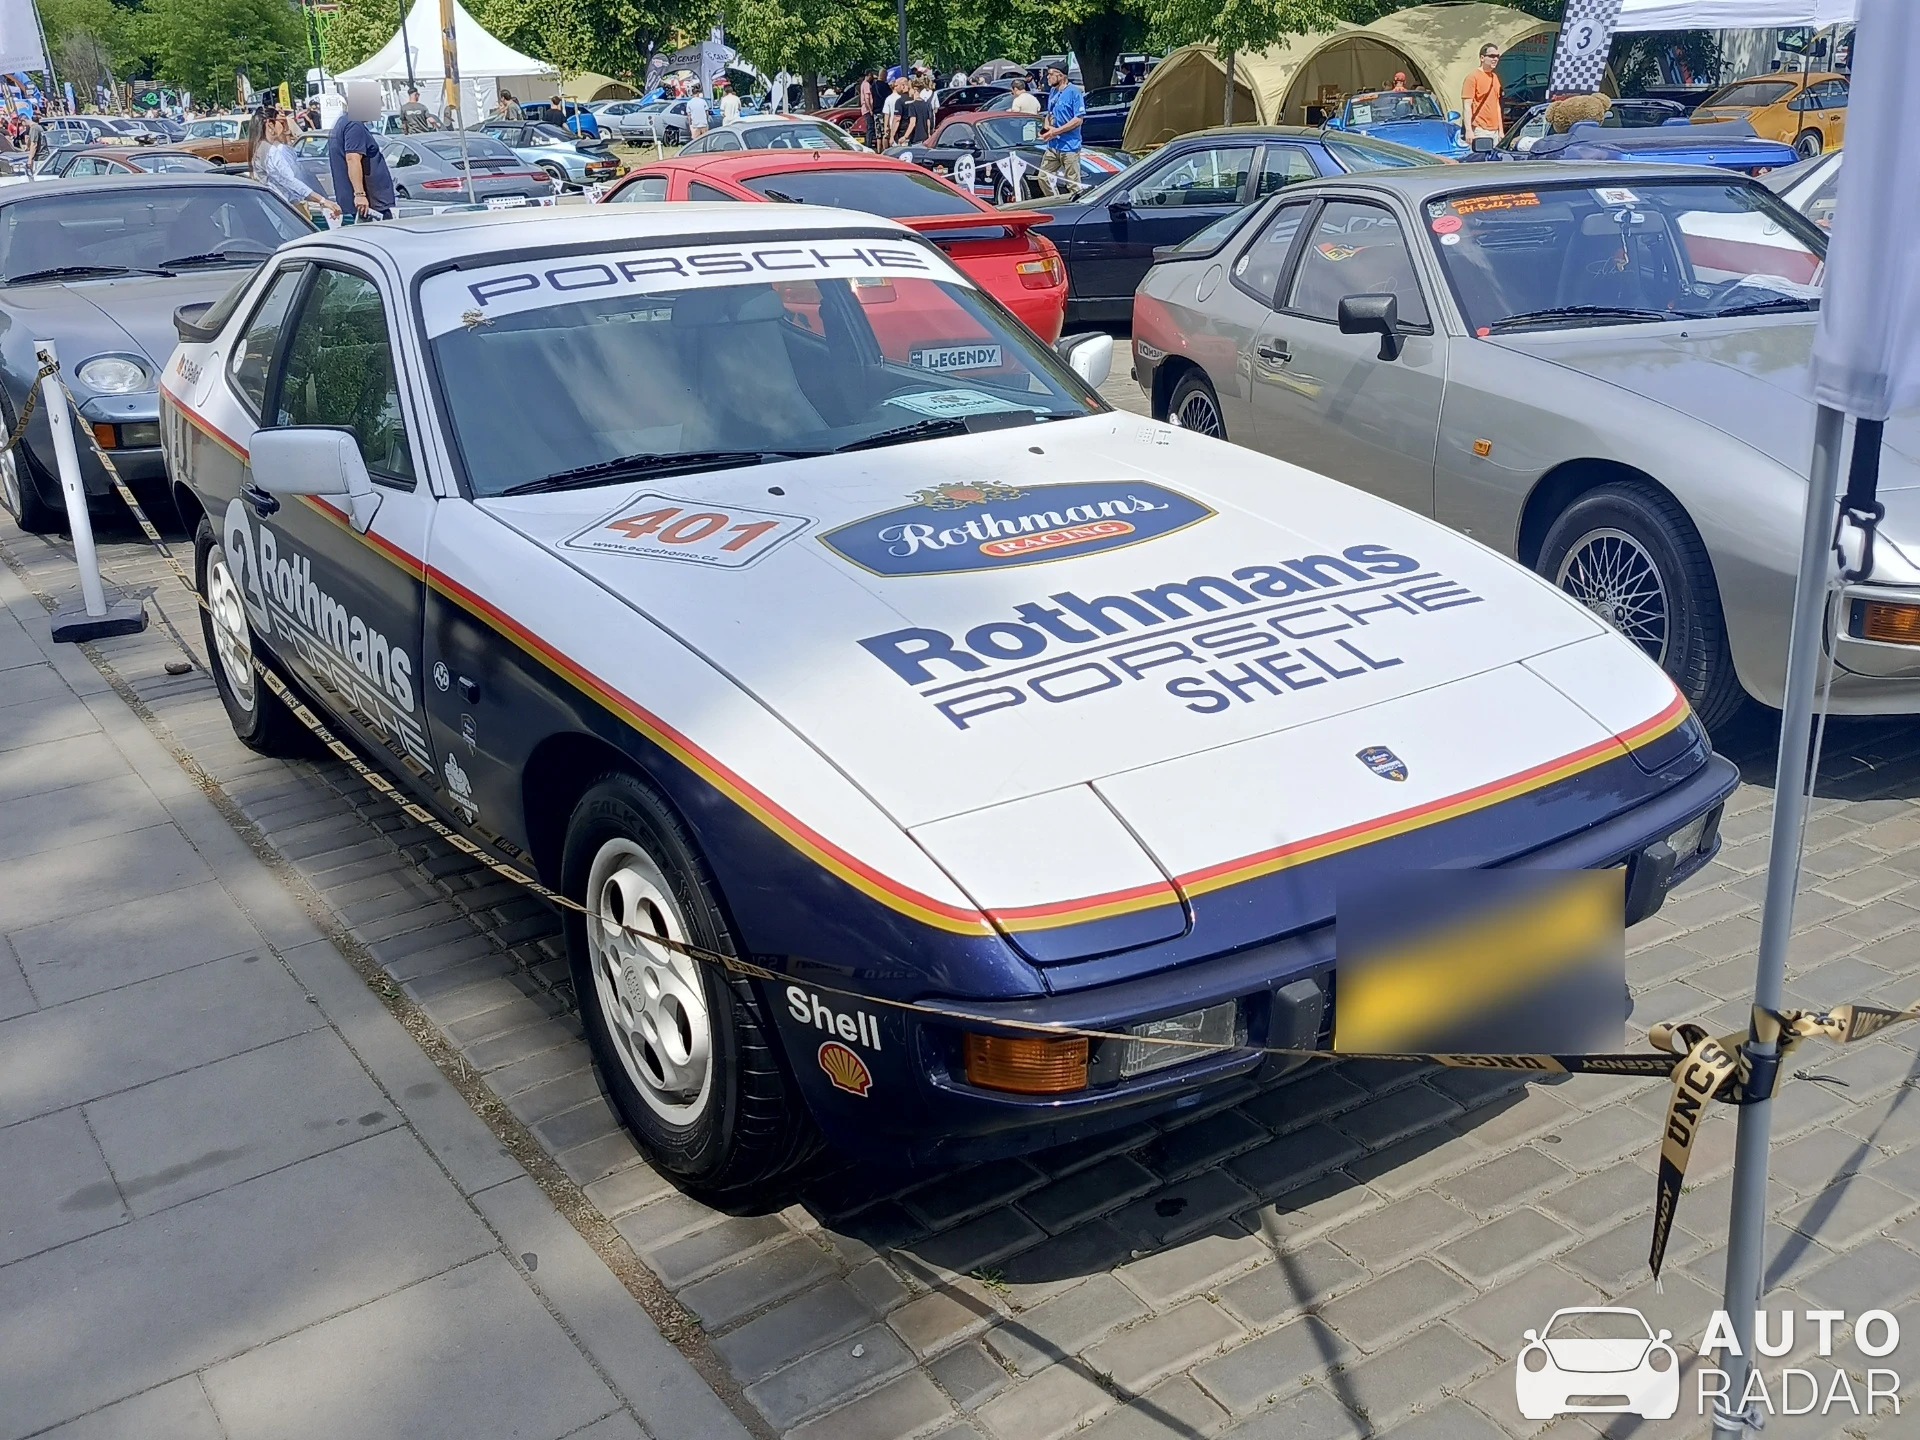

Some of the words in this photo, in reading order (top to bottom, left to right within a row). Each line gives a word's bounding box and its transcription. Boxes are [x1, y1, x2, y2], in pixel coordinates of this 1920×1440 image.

[1576, 27, 1592, 49] 3
[467, 248, 930, 306] PORSCHE
[928, 349, 996, 368] LEGENDY
[592, 541, 718, 562] www.eccehomo.cz
[604, 507, 780, 552] 401
[878, 495, 1169, 557] Rothmans
[997, 522, 1120, 553] RACING
[233, 529, 266, 613] 2
[260, 524, 415, 713] Rothmans
[856, 544, 1420, 685] Rothmans
[932, 572, 1486, 731] PORSCHE
[1165, 639, 1405, 714] SHELL
[270, 610, 435, 775] PORSCHE
[282, 690, 299, 708] UNCS
[315, 727, 334, 742] UNCS
[350, 760, 371, 774] UNCS
[387, 790, 410, 805] UNCS
[428, 821, 453, 835] UNCS
[473, 852, 499, 865] UNCS
[448, 789, 479, 813] MICHELIN
[786, 985, 882, 1051] Shell
[1853, 1011, 1892, 1038] UNCS
[1449, 1055, 1547, 1069] UNCS
[1582, 1059, 1677, 1072] LEGENDY
[1667, 1042, 1733, 1148] UNCS
